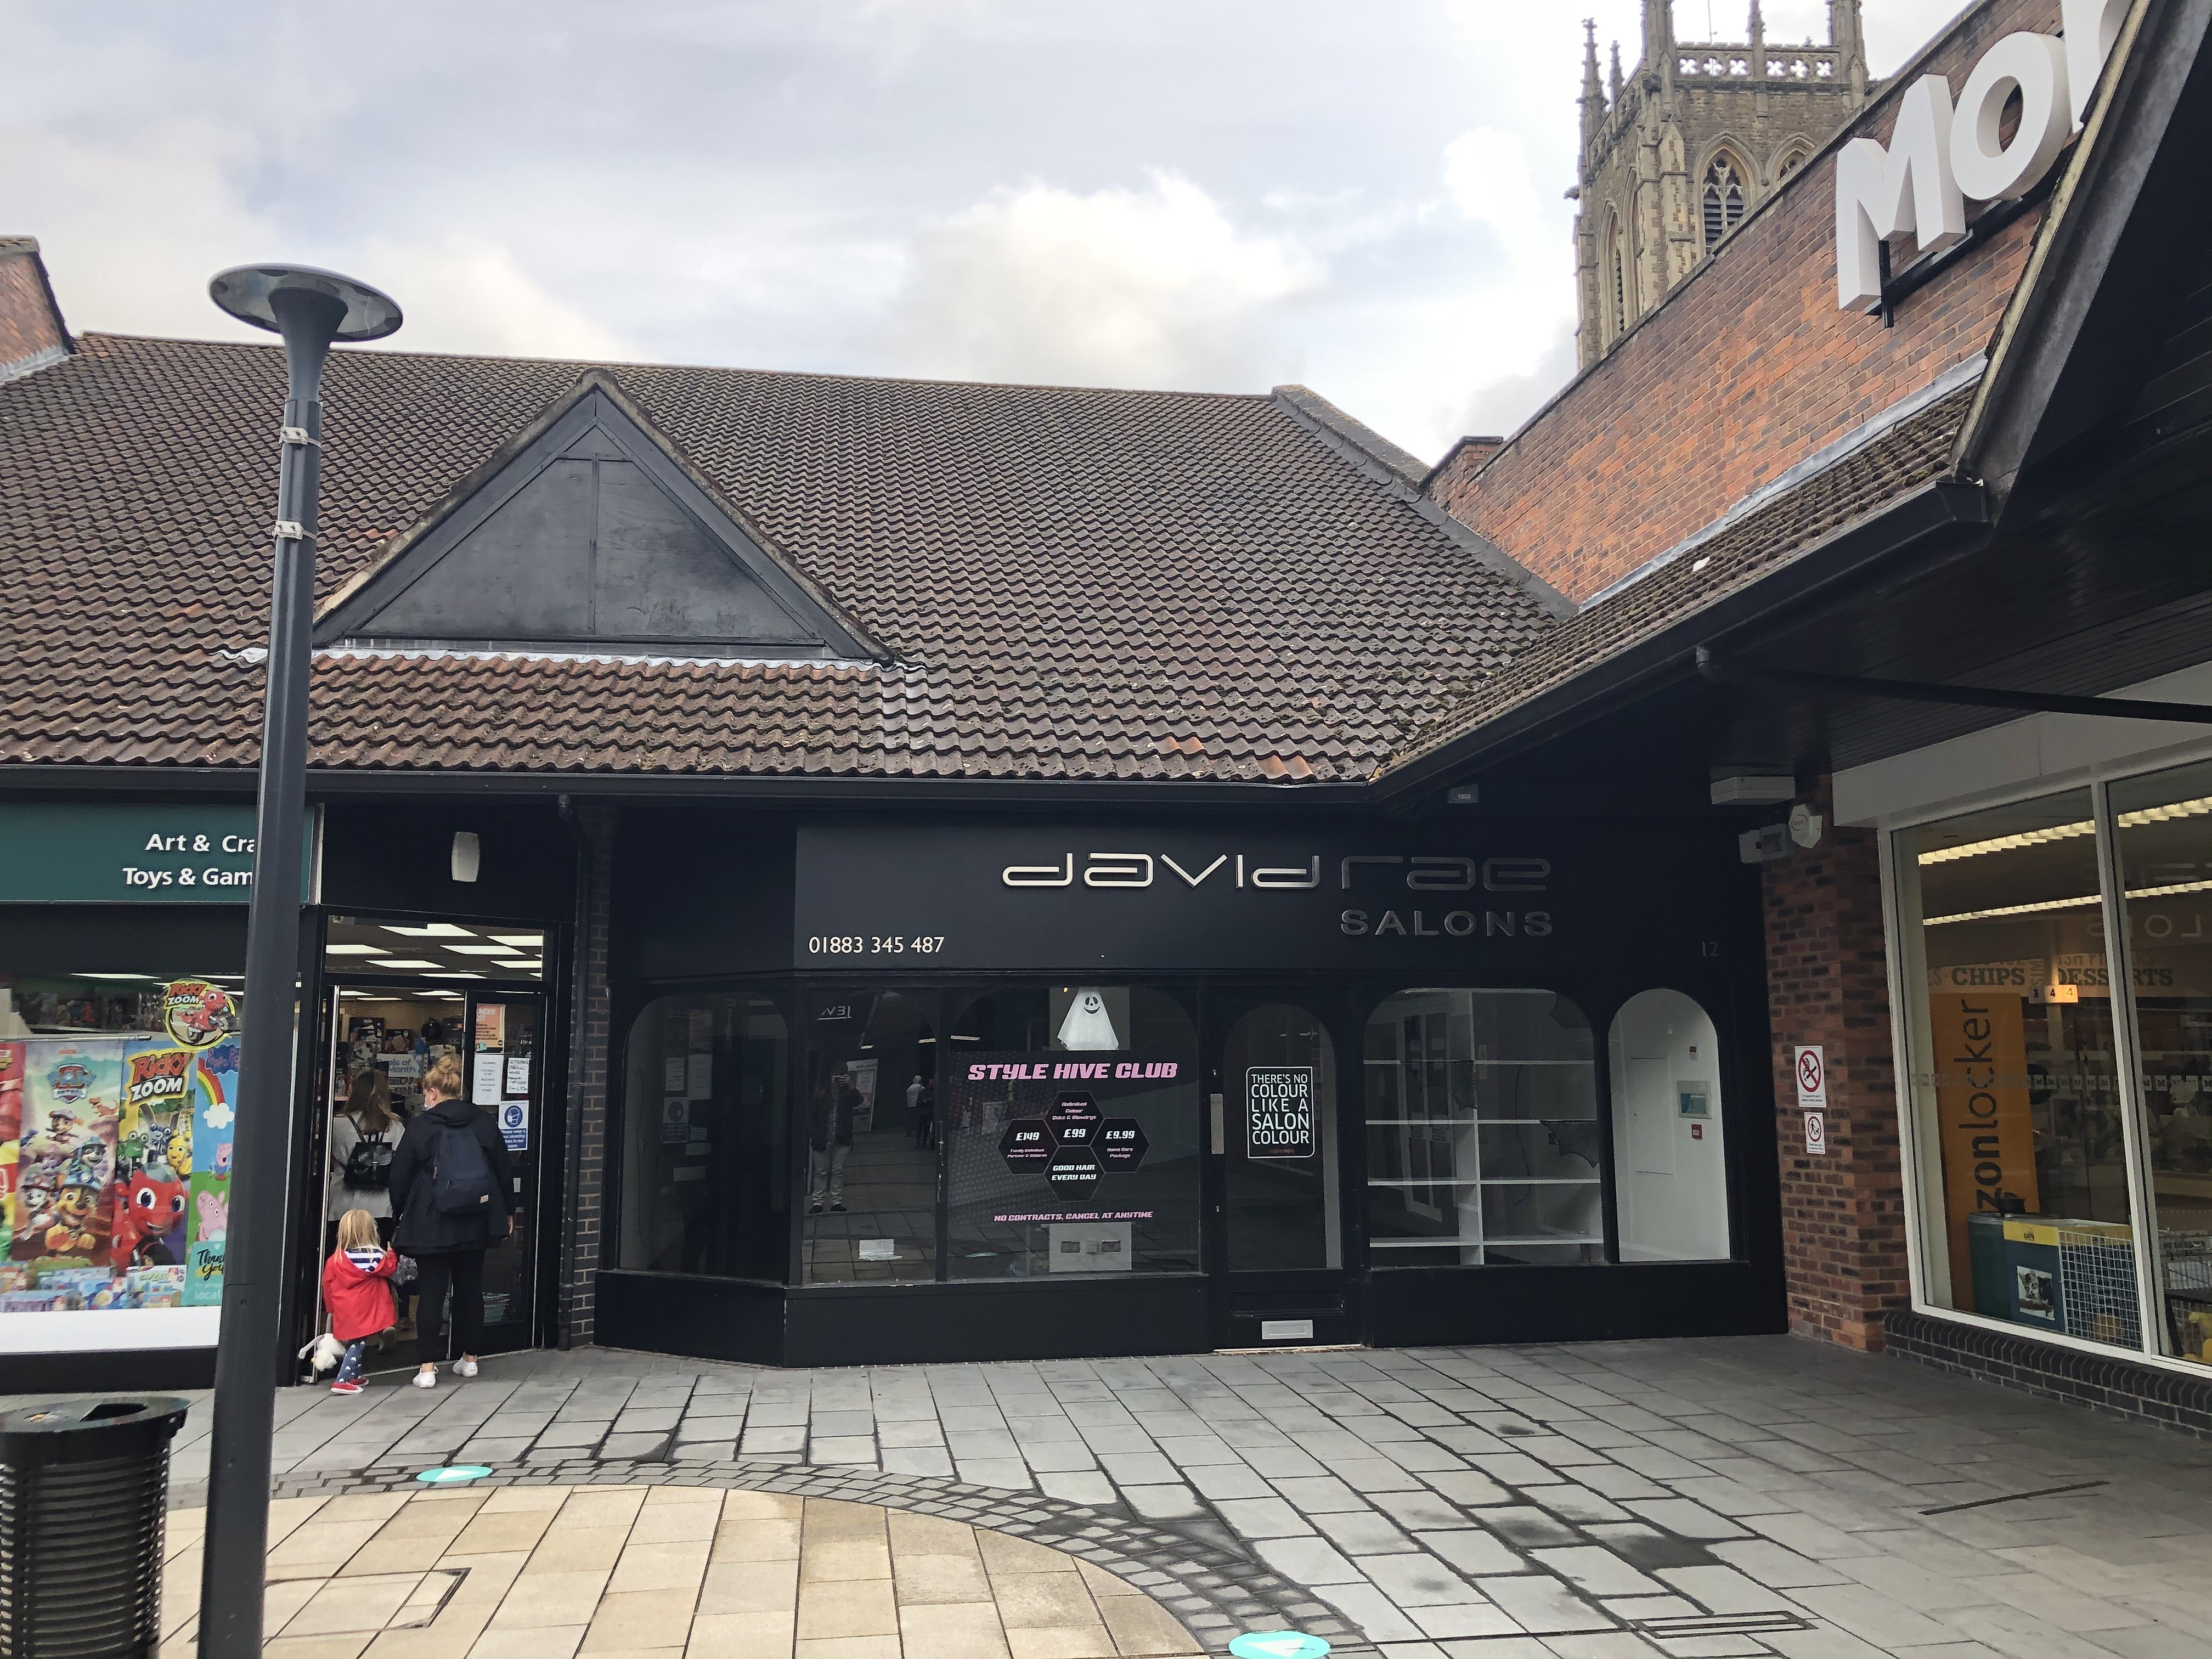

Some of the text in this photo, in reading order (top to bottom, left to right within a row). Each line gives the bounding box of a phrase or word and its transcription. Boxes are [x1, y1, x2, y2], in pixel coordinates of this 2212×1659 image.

[145, 834, 255, 852] Art & Cra
[122, 867, 253, 889] Toys & Gam
[1002, 853, 1551, 891] david rae
[1341, 910, 1553, 936] SALONS
[809, 936, 945, 953] 01883 345 487
[1701, 941, 1719, 957] 12
[1951, 967, 2025, 986] CHIPS
[2058, 968, 2173, 986] DESSRTS
[167, 996, 199, 1006] ZOOM
[968, 1063, 1178, 1080] STYLE HIVE CLUB
[1251, 1073, 1308, 1085] THERE'S NO
[131, 1077, 183, 1102] ZOOM
[1251, 1084, 1308, 1098] COLOUR
[1251, 1098, 1309, 1113] LIKE A
[1953, 998, 2002, 1211] zonlocker
[1252, 1113, 1310, 1130] SALON
[1015, 1132, 1040, 1141] £149
[1063, 1128, 1086, 1138] £99
[1105, 1130, 1135, 1139] £9.99
[1252, 1131, 1310, 1145] COLOUR
